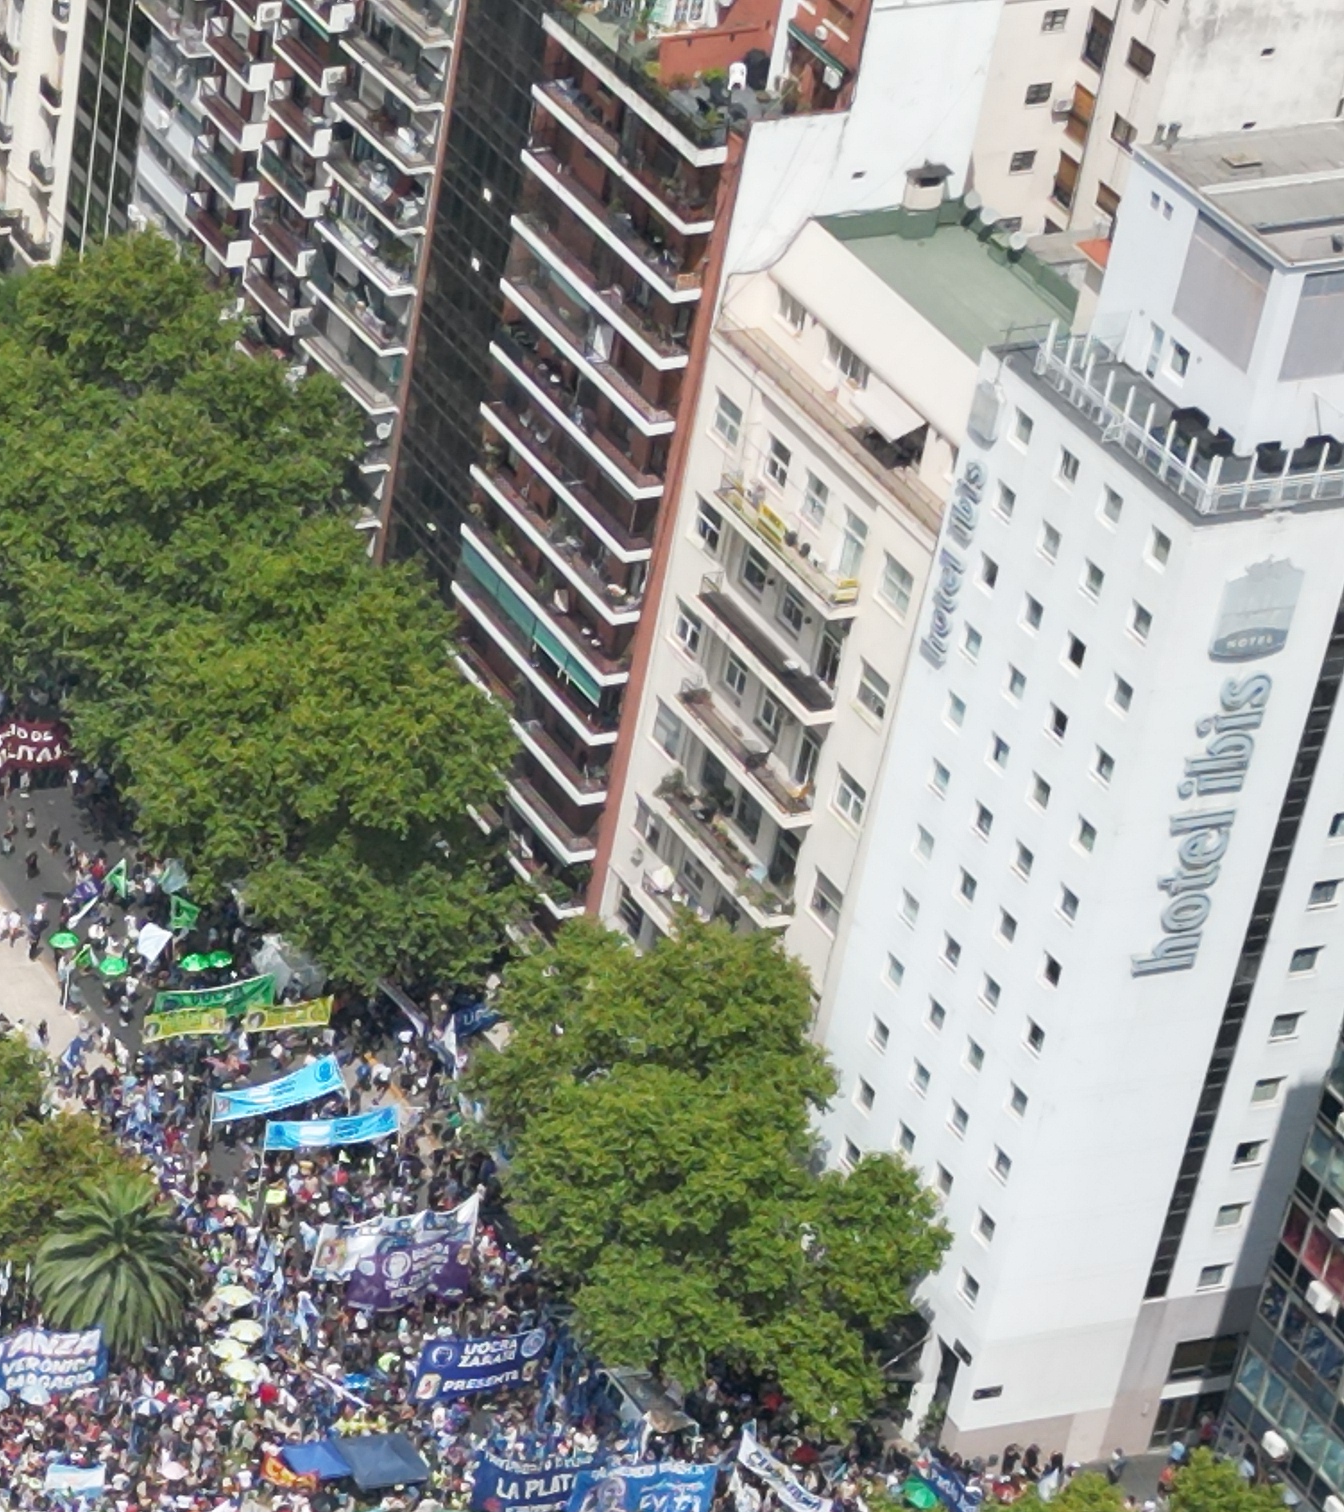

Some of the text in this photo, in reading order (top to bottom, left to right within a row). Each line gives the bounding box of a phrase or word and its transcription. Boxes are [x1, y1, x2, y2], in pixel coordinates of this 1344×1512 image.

[919, 548, 968, 671] hotel
[1226, 634, 1274, 649] HOTEL
[1178, 670, 1272, 800] ibis
[1131, 808, 1237, 978] hotel
[442, 1370, 519, 1393] PRESENTE
[496, 1474, 575, 1500] LA PLAT
